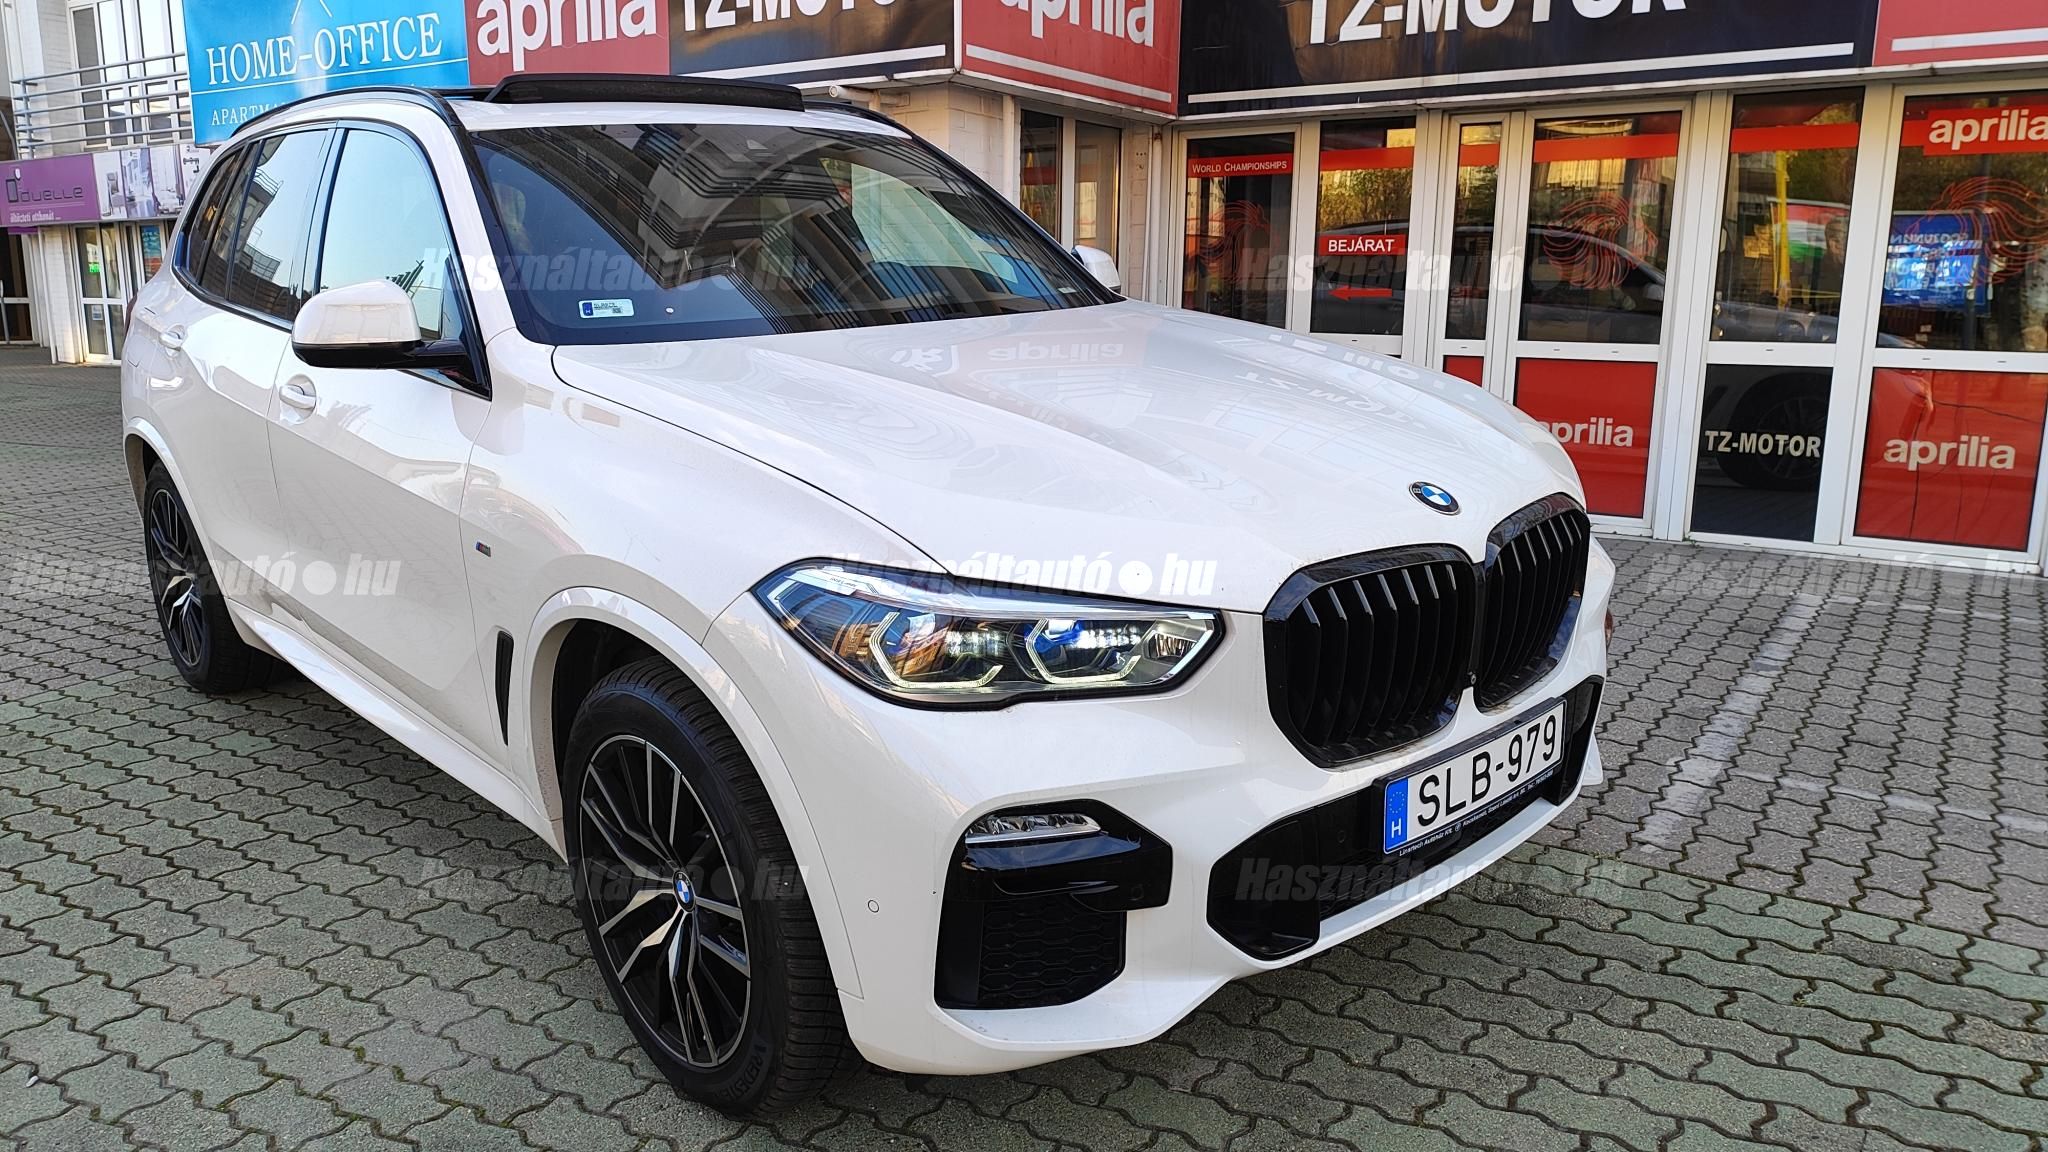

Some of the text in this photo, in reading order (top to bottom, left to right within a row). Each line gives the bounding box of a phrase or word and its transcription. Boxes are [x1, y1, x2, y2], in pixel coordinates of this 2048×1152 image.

[683, 0, 898, 31] TZ-MO
[1000, 0, 1154, 48] prilia
[1308, 0, 1687, 44] TZ-MO
[207, 12, 442, 86] HOME-OFFICE
[476, 0, 656, 71] aprilia
[211, 103, 286, 126] APARTM
[1929, 109, 2048, 150] aprilia
[1224, 160, 1287, 172] CHAMPIONSHIPS
[1328, 237, 1395, 252] BEJÁRAT
[1705, 430, 1821, 459] TZ-MOTOR
[1884, 435, 2016, 471] aprilia
[1417, 715, 1556, 827] SLB-979
[1391, 818, 1402, 839] H
